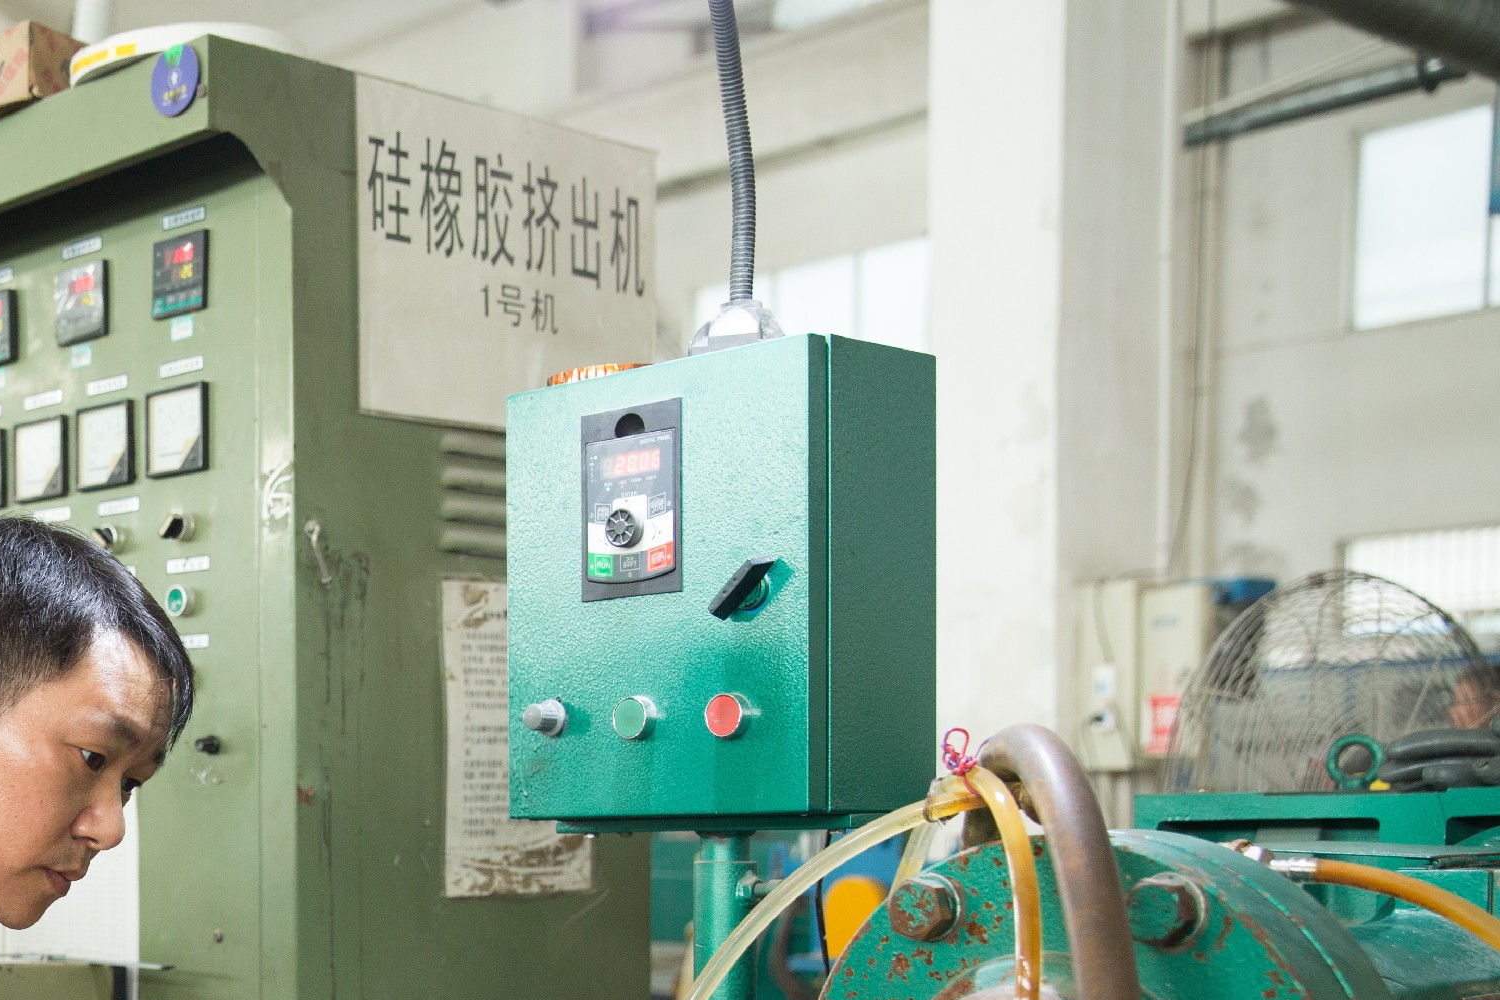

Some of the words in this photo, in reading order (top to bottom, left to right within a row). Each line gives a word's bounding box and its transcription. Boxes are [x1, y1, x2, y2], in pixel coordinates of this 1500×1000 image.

[368, 131, 645, 297] 硅橡胶挤出机
[481, 283, 558, 335] 1号机
[596, 560, 611, 569] RUN
